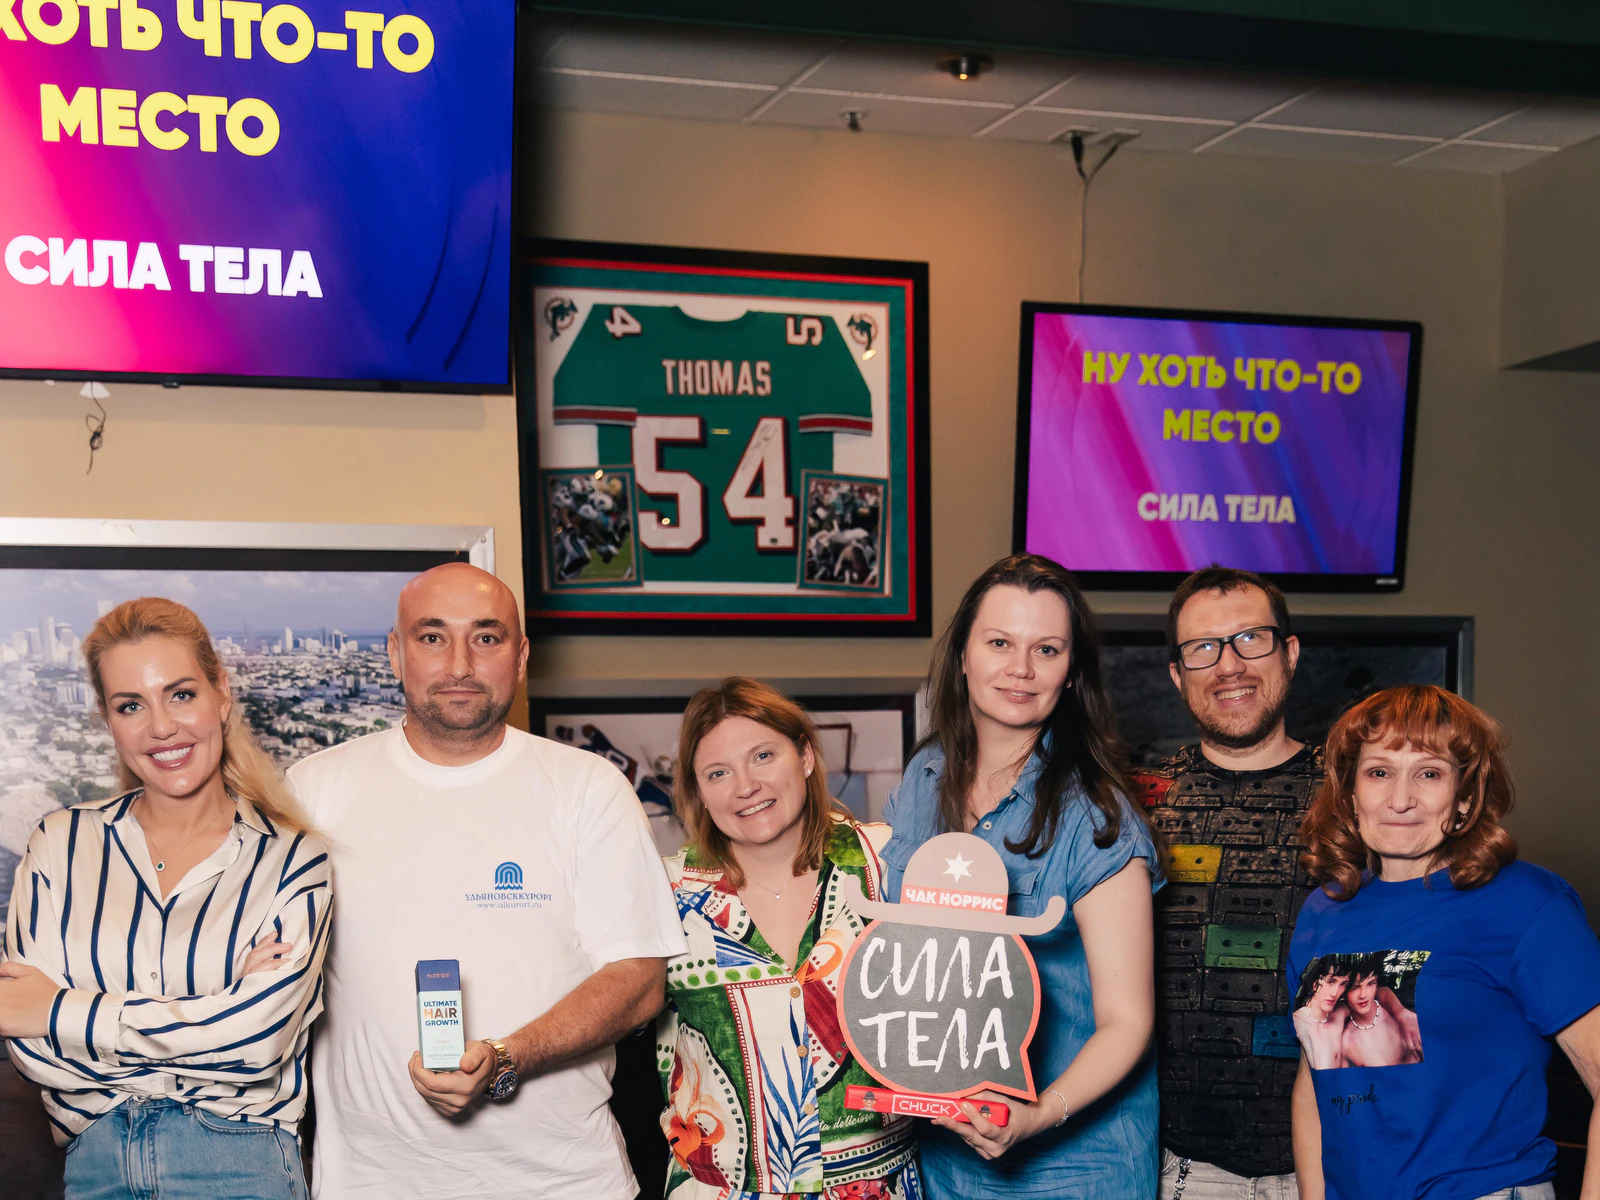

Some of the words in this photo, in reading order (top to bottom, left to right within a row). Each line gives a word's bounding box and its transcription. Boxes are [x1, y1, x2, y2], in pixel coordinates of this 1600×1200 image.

[176, 0, 435, 73] ЧТО-ТО
[40, 84, 281, 157] МЕСТО
[5, 235, 171, 291] СИЛА
[179, 244, 323, 299] ТЕЛА
[661, 358, 773, 396] THOMAS
[1083, 351, 1132, 385] НУ
[1137, 354, 1227, 391] ХОТЬ
[1233, 358, 1362, 395] ЧТО-ТО
[1163, 409, 1281, 445] МЕСТО
[631, 414, 798, 552] 54
[1137, 492, 1219, 523] СИЛА
[1224, 494, 1296, 524] ТЕЛА
[465, 893, 552, 901] УЛЬЯНОВСККУРОРТ
[905, 888, 938, 904] ЧАК
[938, 892, 1004, 911] НОРРИС
[859, 936, 1014, 1002] СИЛА
[423, 1007, 458, 1019] HAIR
[859, 1007, 1011, 1073] ТЕЛА
[899, 1100, 950, 1116] CHUCK
